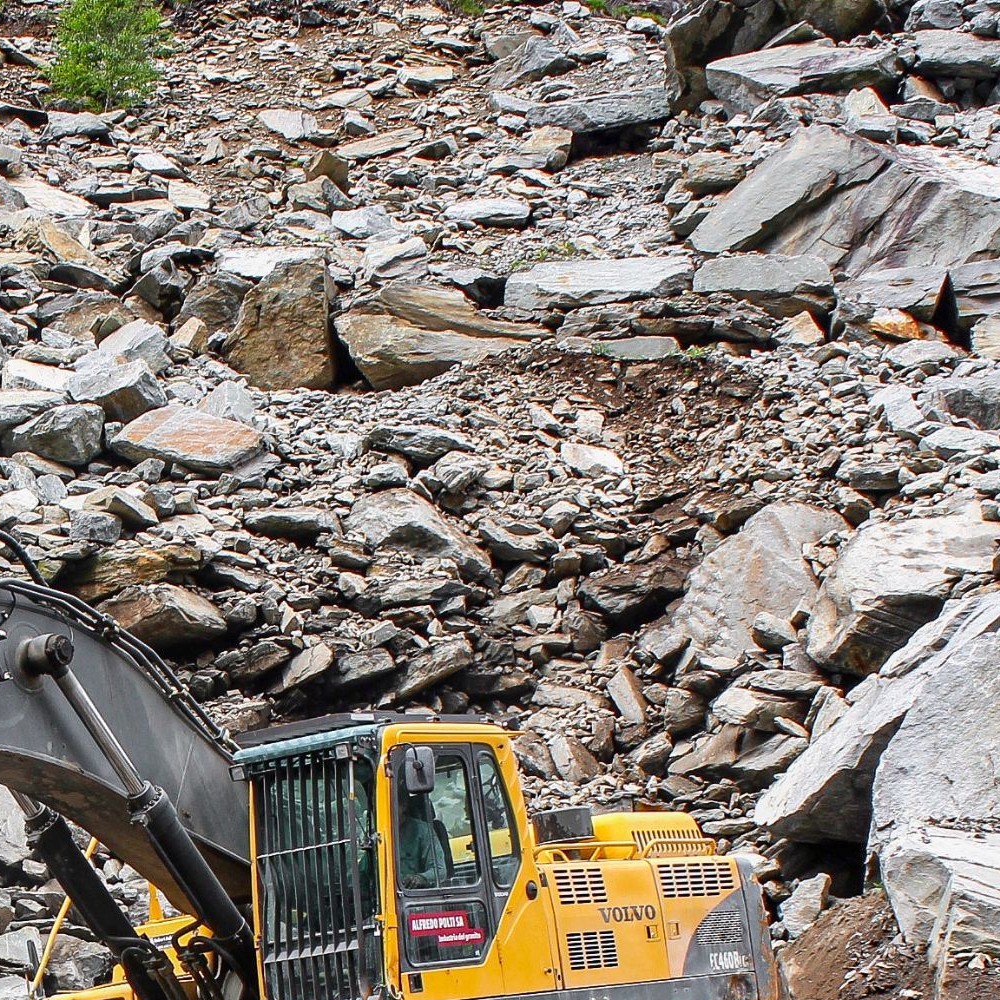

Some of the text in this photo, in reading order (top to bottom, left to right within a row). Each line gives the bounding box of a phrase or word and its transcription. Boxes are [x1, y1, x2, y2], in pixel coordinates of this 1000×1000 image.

[597, 905, 656, 923] VOLVO
[411, 916, 464, 931] ALFREDO POLTI SA
